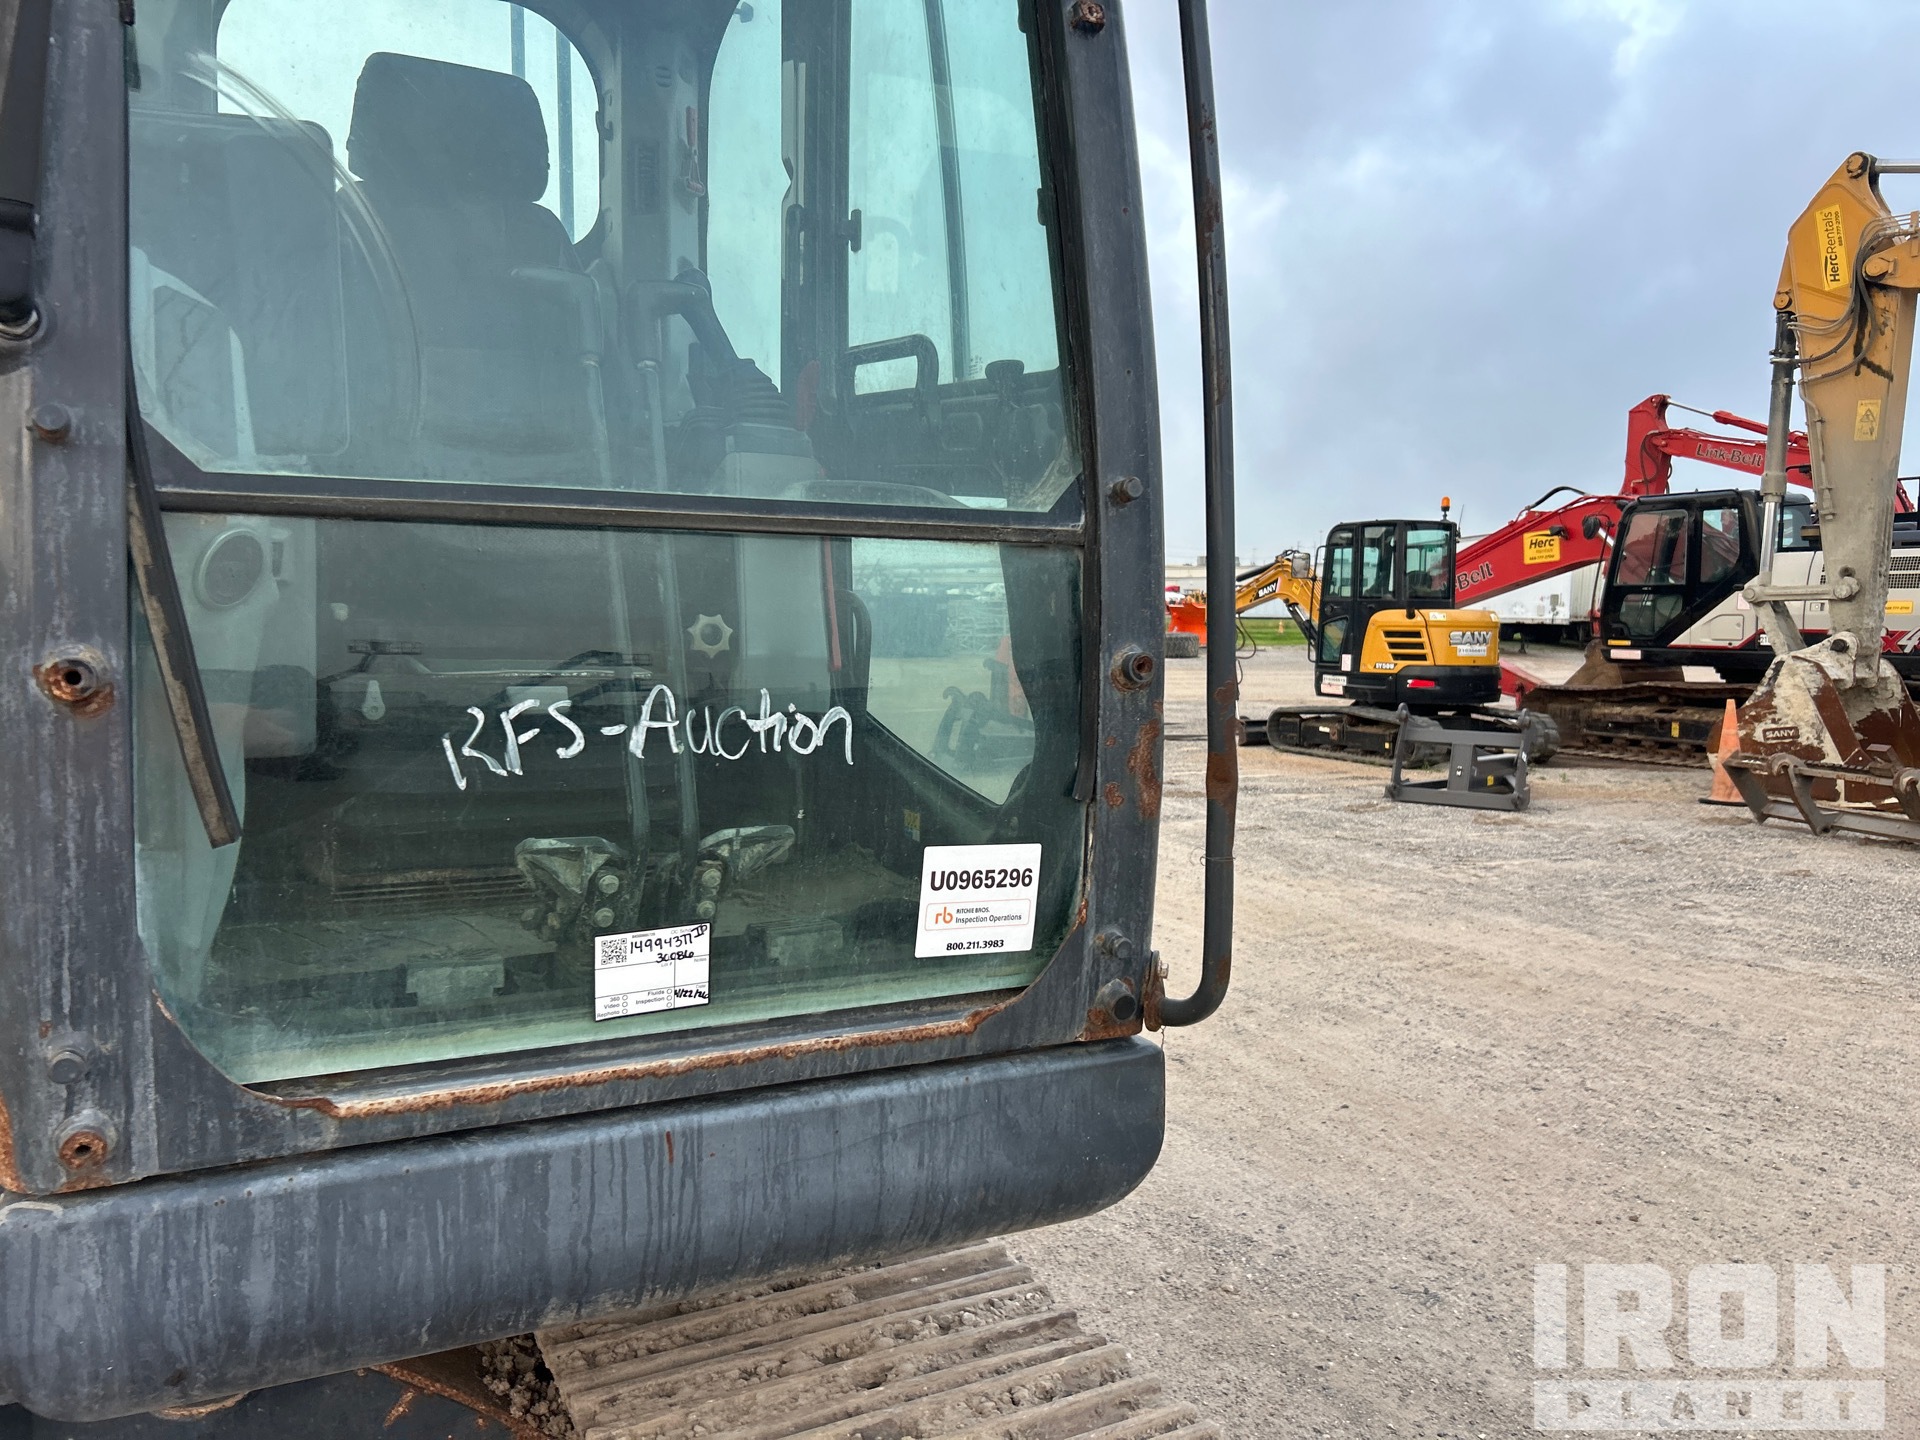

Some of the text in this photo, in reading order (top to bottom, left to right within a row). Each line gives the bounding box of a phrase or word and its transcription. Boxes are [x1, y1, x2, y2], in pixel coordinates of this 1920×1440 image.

[1696, 443, 1763, 467] Link-Belt
[1529, 538, 1555, 549] Herc
[1449, 631, 1492, 646] SANY
[1766, 730, 1794, 738] SANY
[930, 868, 1033, 891] U0965296
[935, 906, 953, 924] rb
[955, 914, 1022, 924] Inspection Operations
[946, 940, 1004, 951] 800.211.3983
